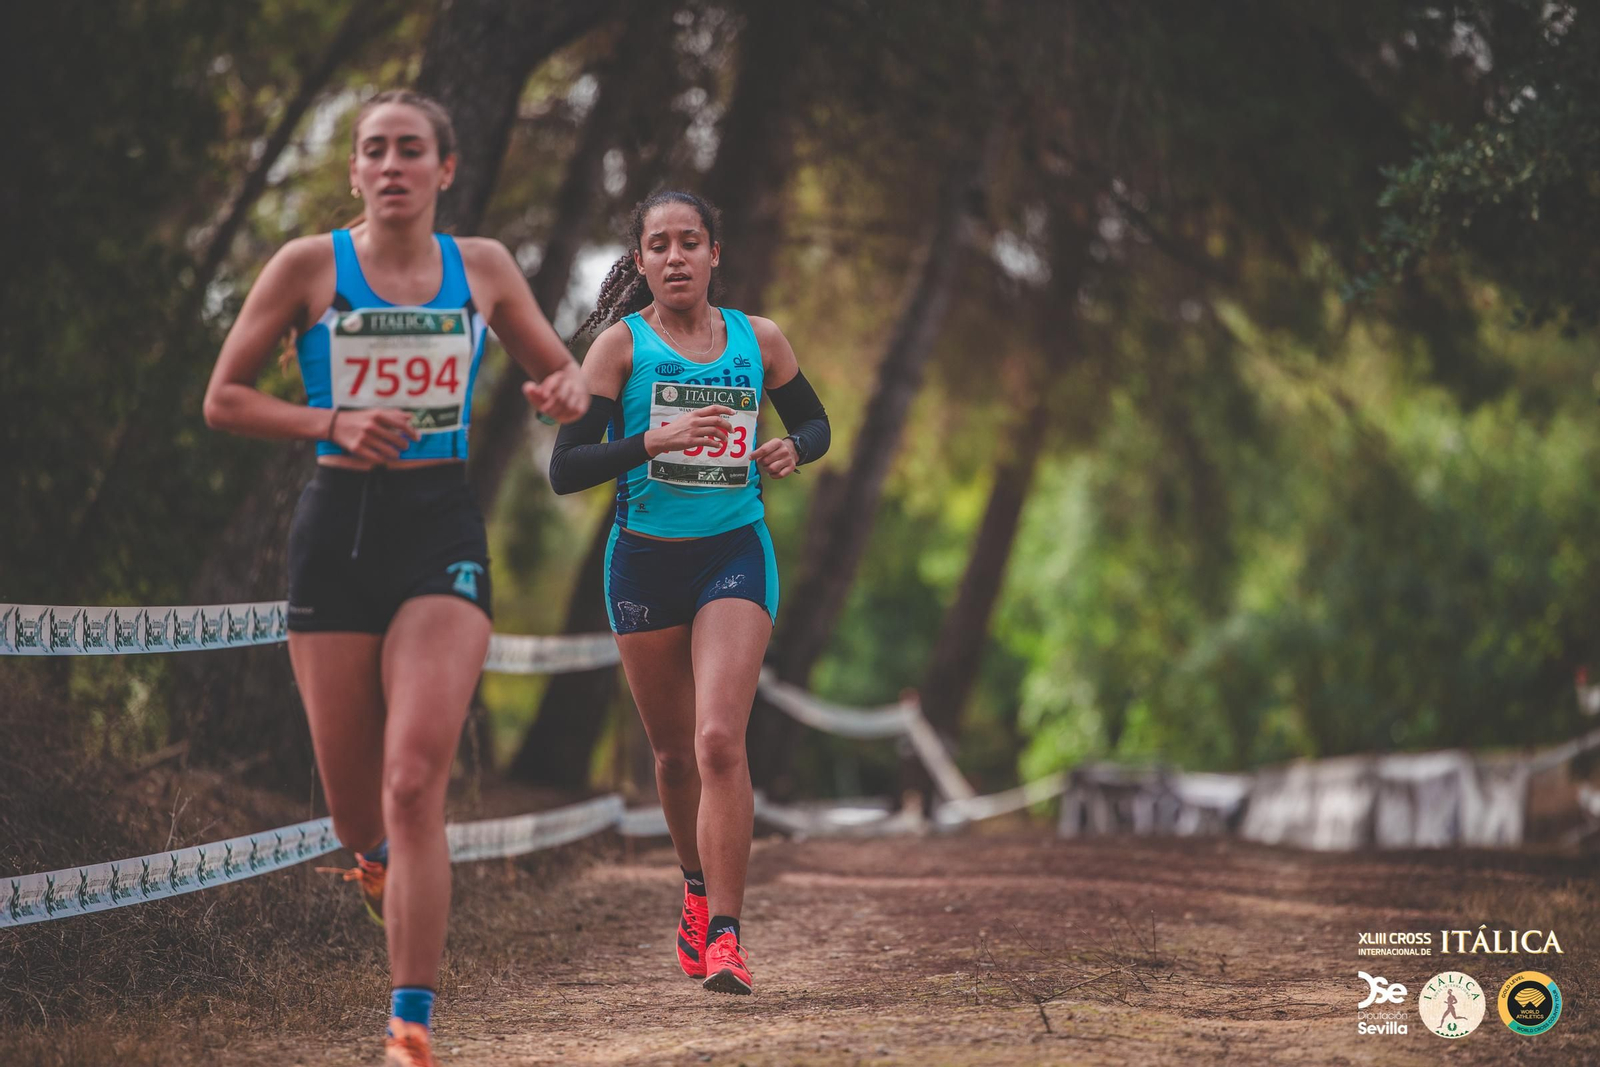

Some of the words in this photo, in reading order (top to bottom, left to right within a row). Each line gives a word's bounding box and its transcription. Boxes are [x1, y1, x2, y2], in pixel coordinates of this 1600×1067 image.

[656, 363, 684, 374] TROPS
[344, 355, 459, 398] 7594
[684, 388, 735, 402] ITÁLICA
